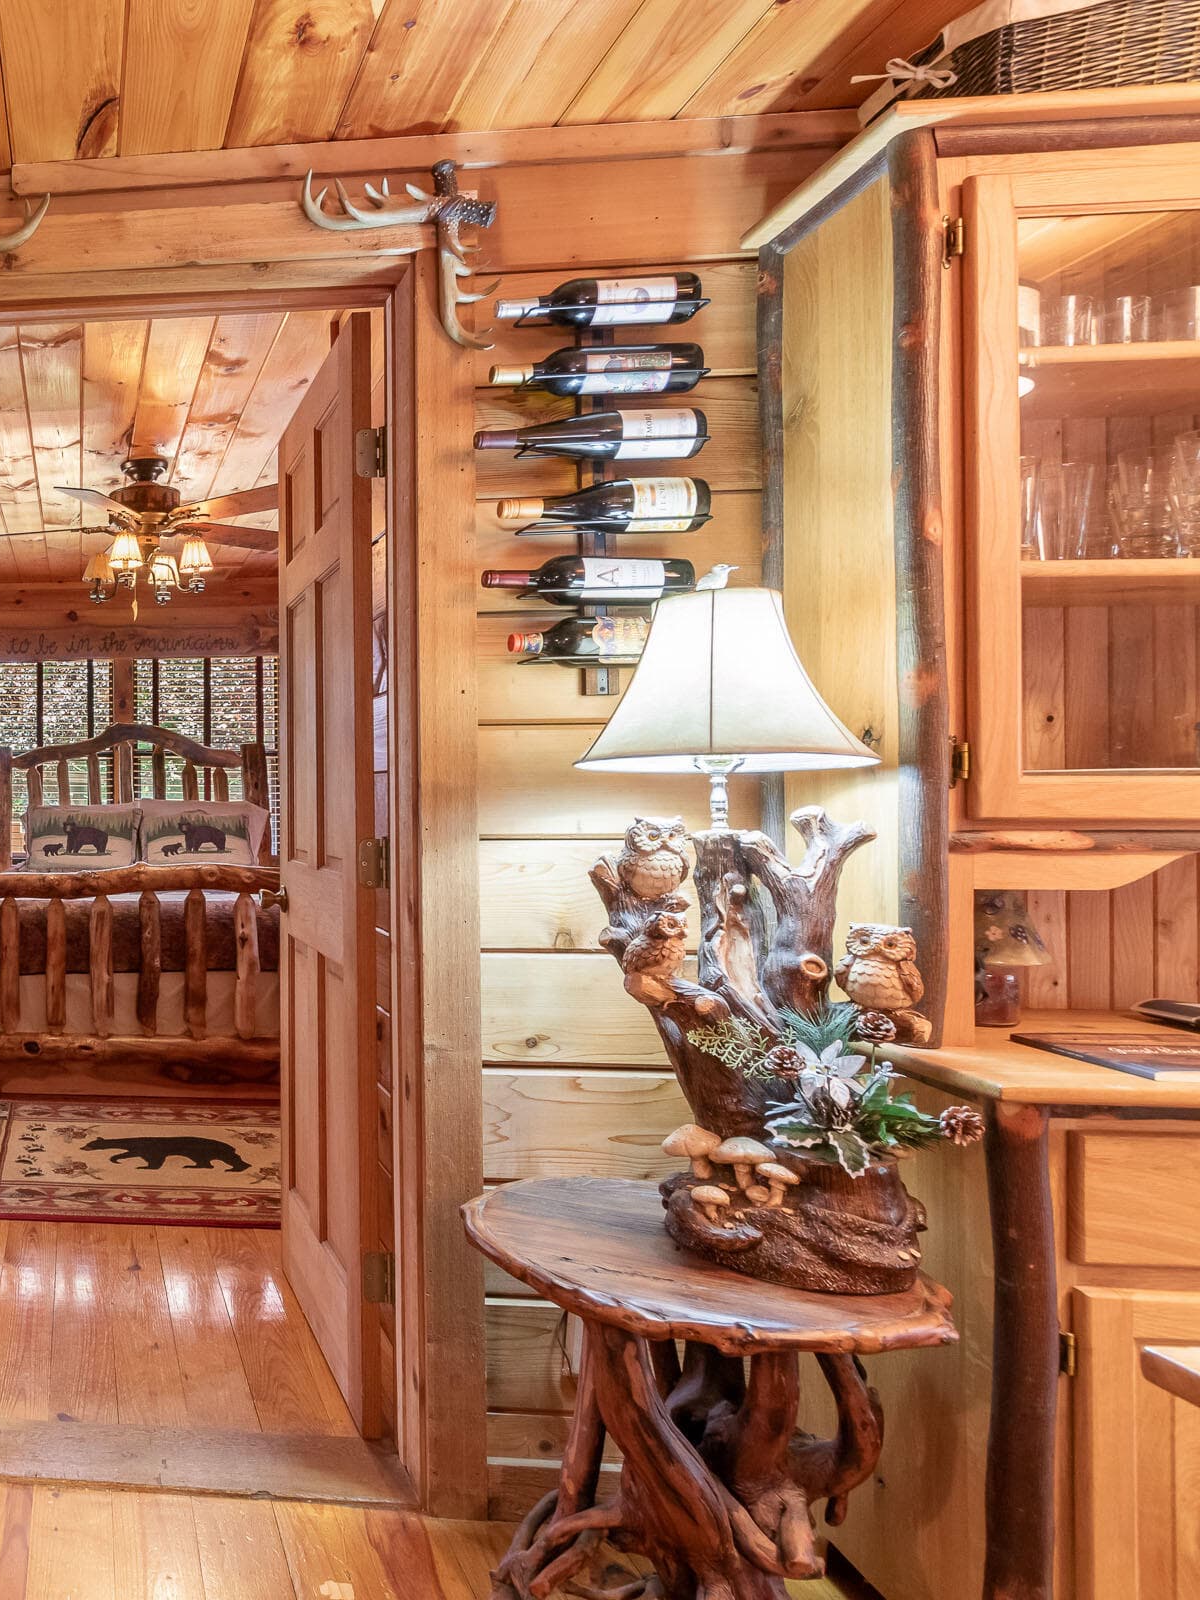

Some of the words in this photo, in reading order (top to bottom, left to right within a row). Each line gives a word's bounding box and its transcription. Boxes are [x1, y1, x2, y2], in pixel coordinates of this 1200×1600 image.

[596, 567, 619, 586] A
[6, 637, 31, 655] to
[35, 633, 58, 655] be
[65, 634, 93, 653] in
[98, 631, 128, 653] the
[134, 633, 240, 653] mountains
